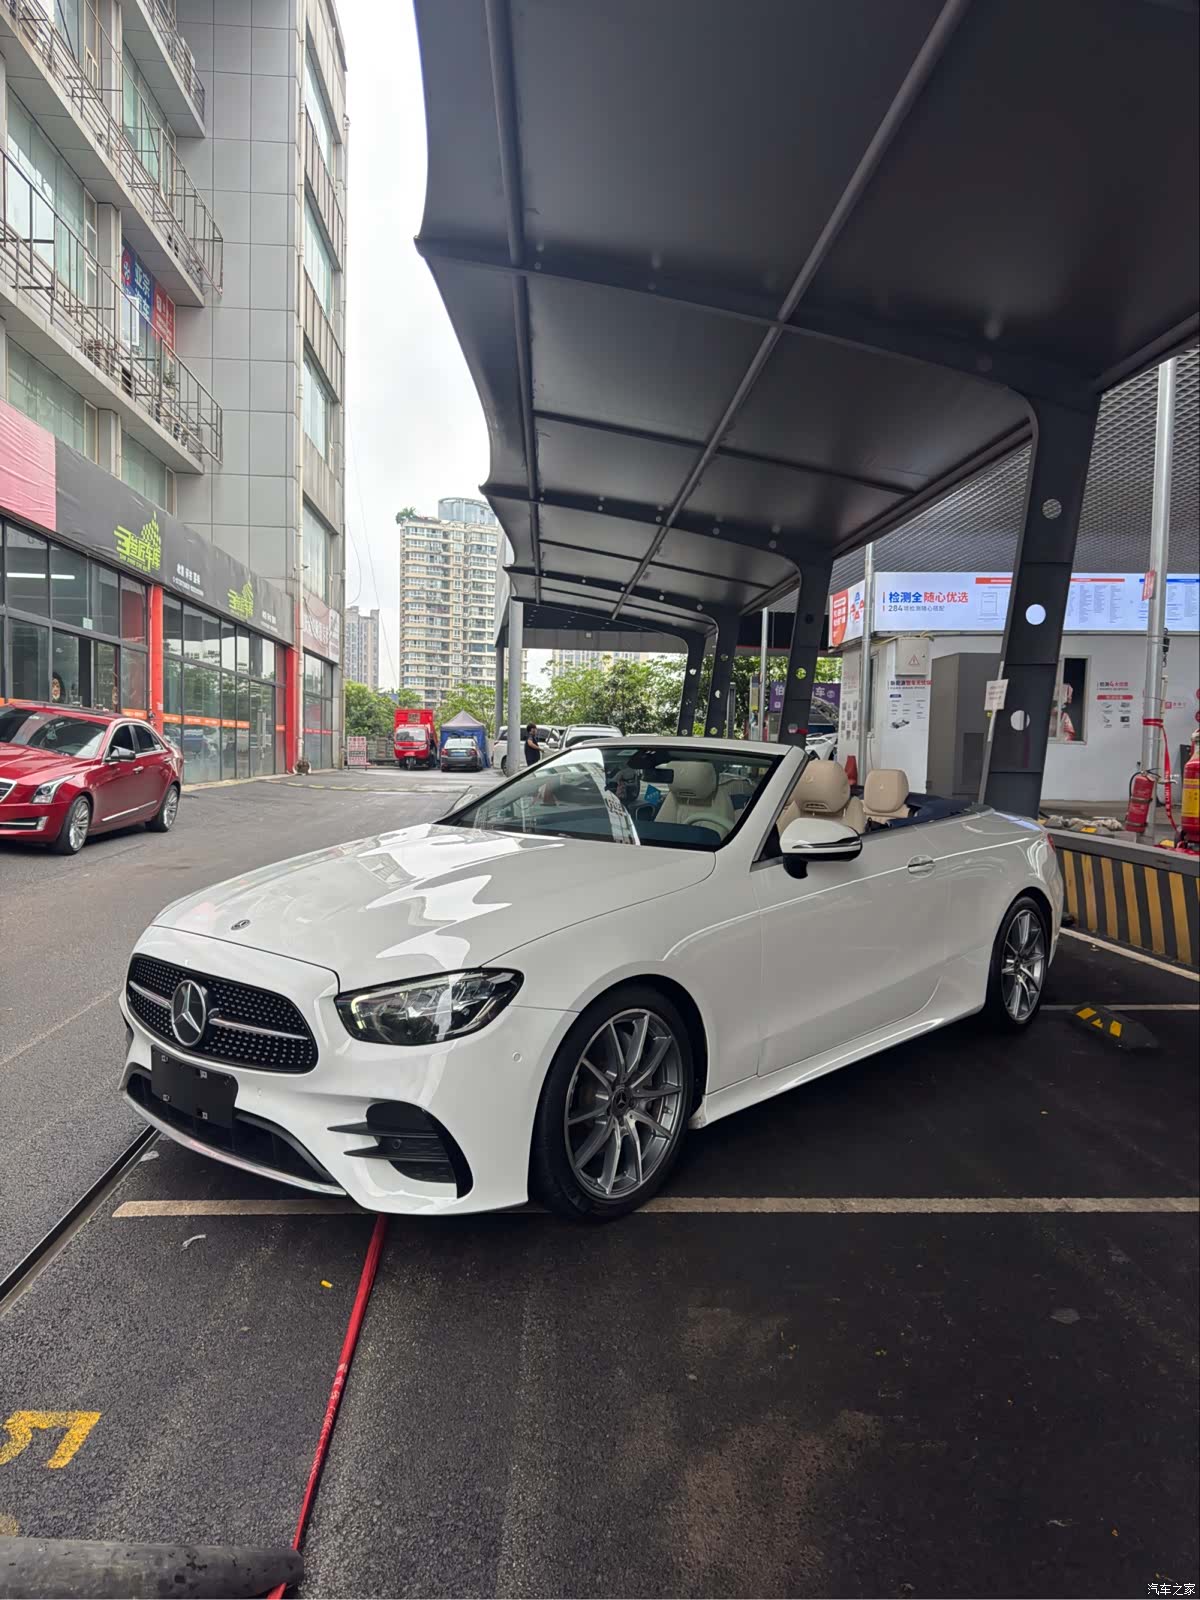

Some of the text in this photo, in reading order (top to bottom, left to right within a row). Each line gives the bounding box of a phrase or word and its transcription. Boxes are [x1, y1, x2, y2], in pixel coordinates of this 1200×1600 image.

[888, 591, 969, 604] 检测全随心优选
